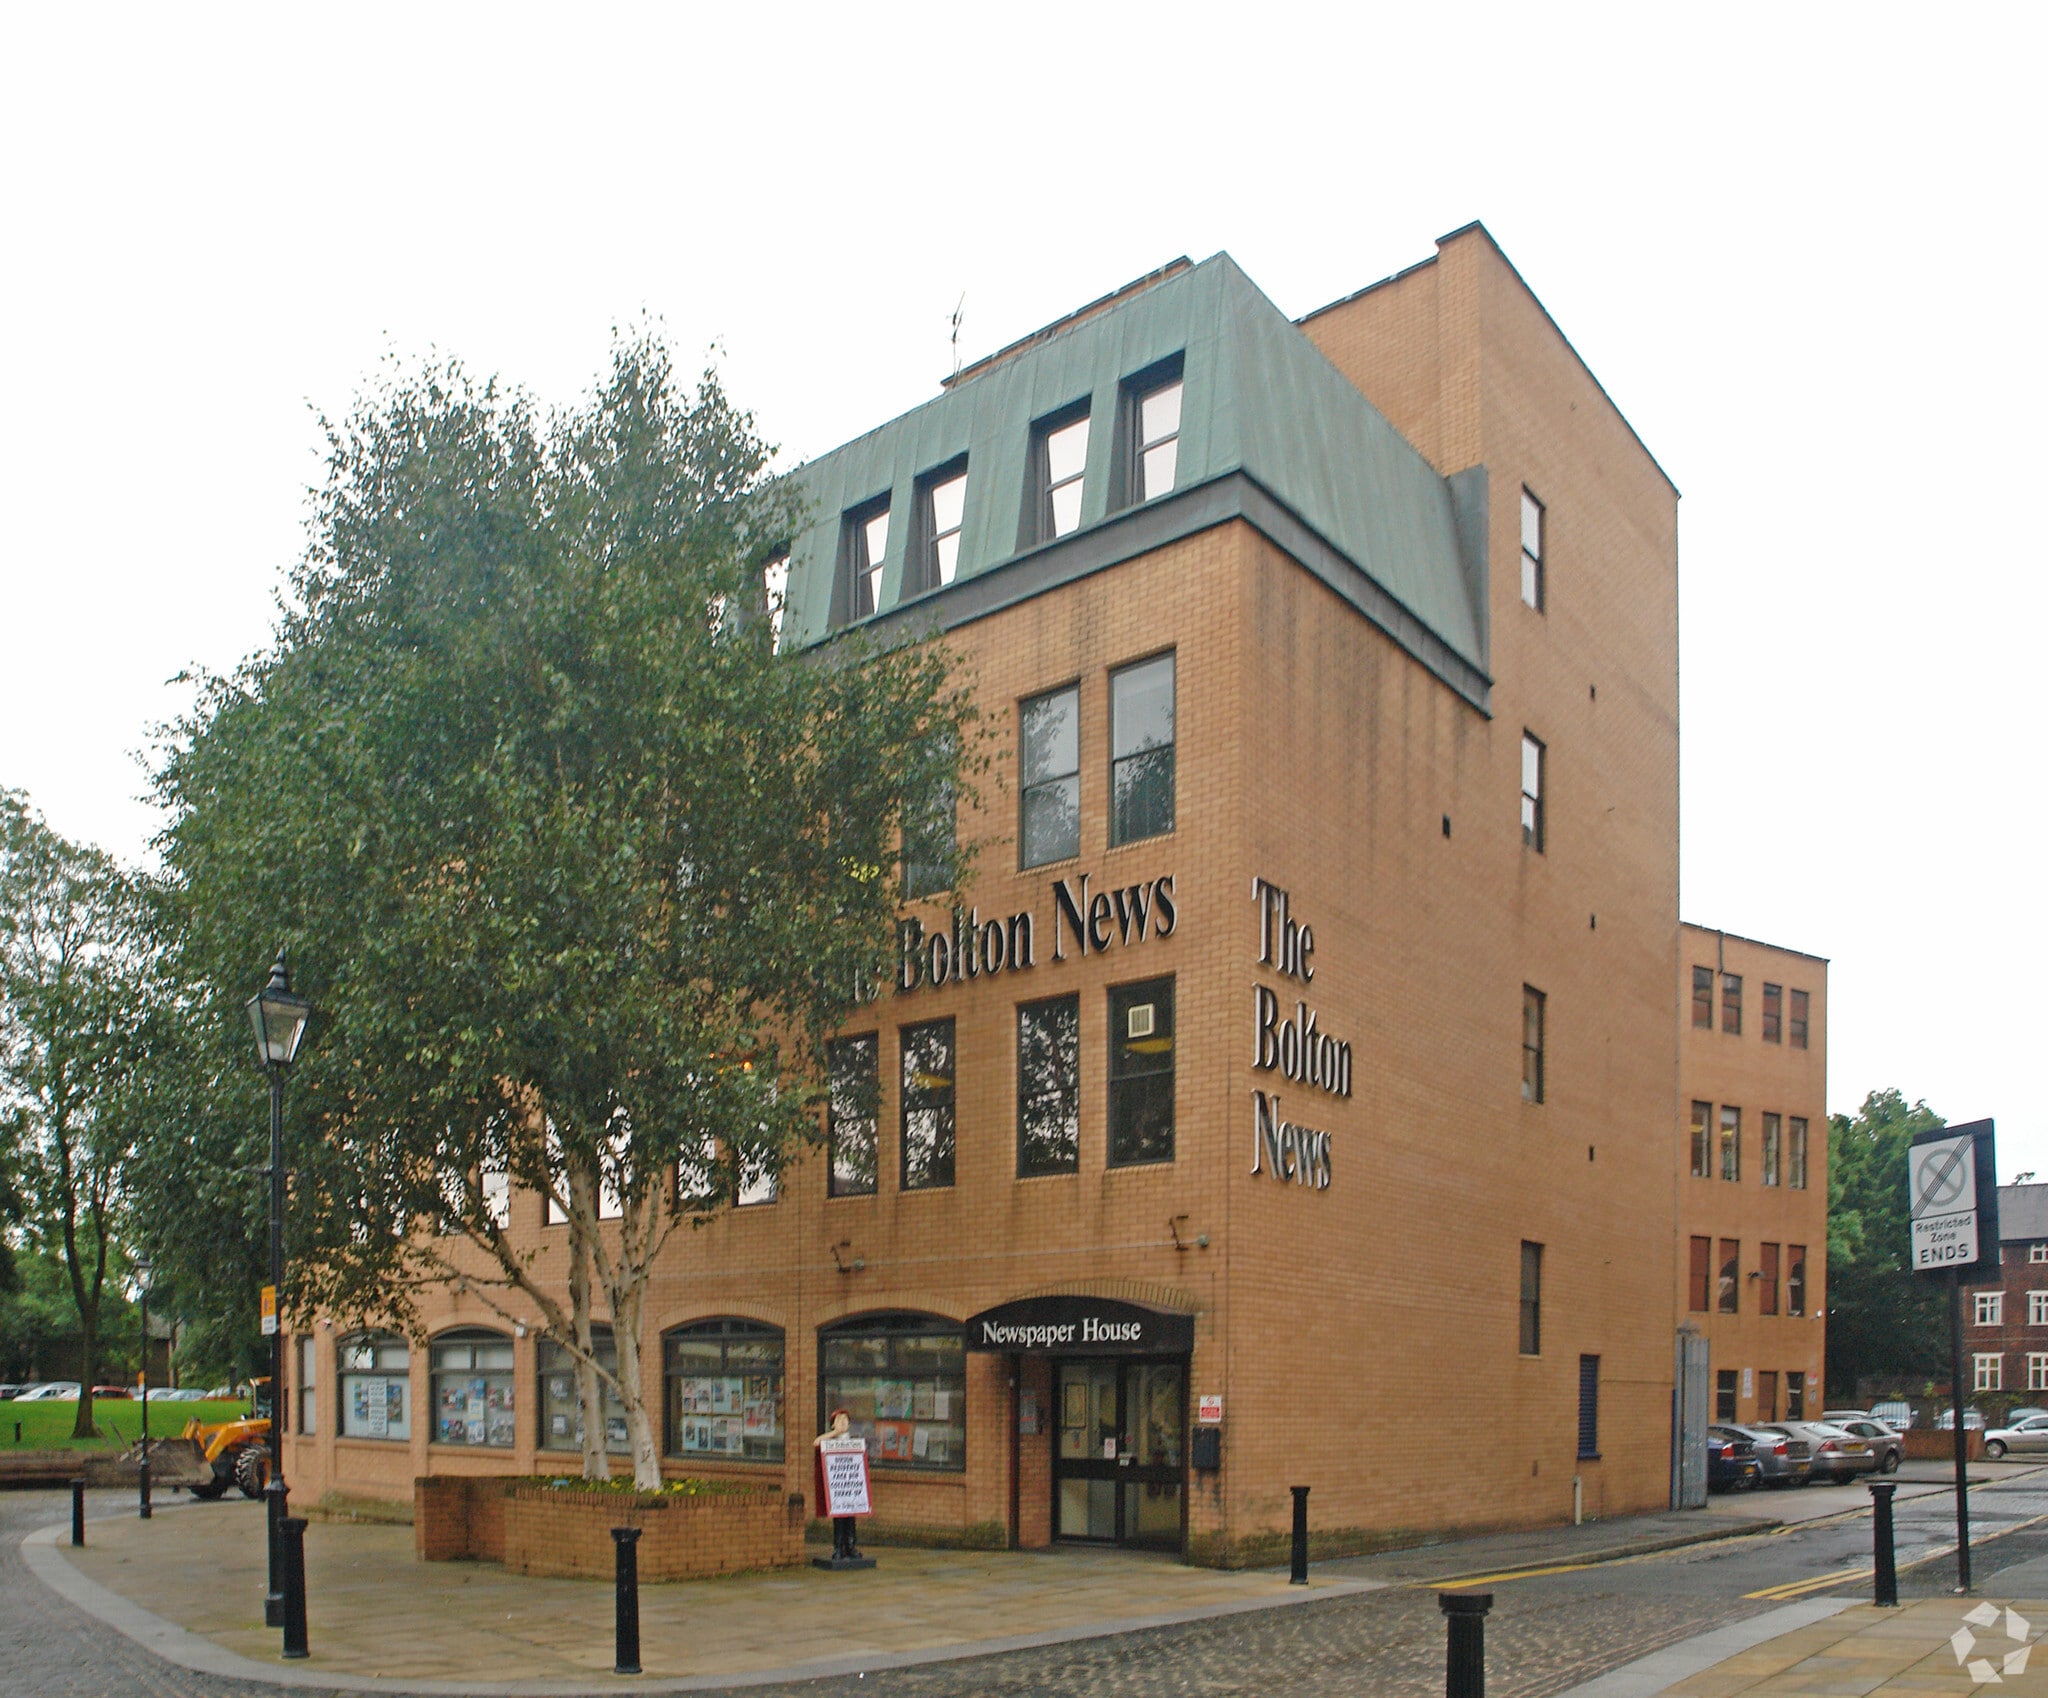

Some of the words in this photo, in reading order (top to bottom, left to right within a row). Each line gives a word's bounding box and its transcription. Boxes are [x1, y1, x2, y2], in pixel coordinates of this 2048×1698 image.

[897, 905, 1036, 993] Bolton
[1051, 873, 1178, 961] News
[1252, 876, 1315, 984] The
[1251, 981, 1352, 1097] Bolton
[1250, 1088, 1332, 1190] News
[1915, 1213, 1973, 1234] Restricted
[1920, 1243, 1969, 1264] ENDS
[1930, 1231, 1957, 1243] Zone
[982, 1321, 1076, 1348] Newspaper
[1081, 1317, 1142, 1342] House
